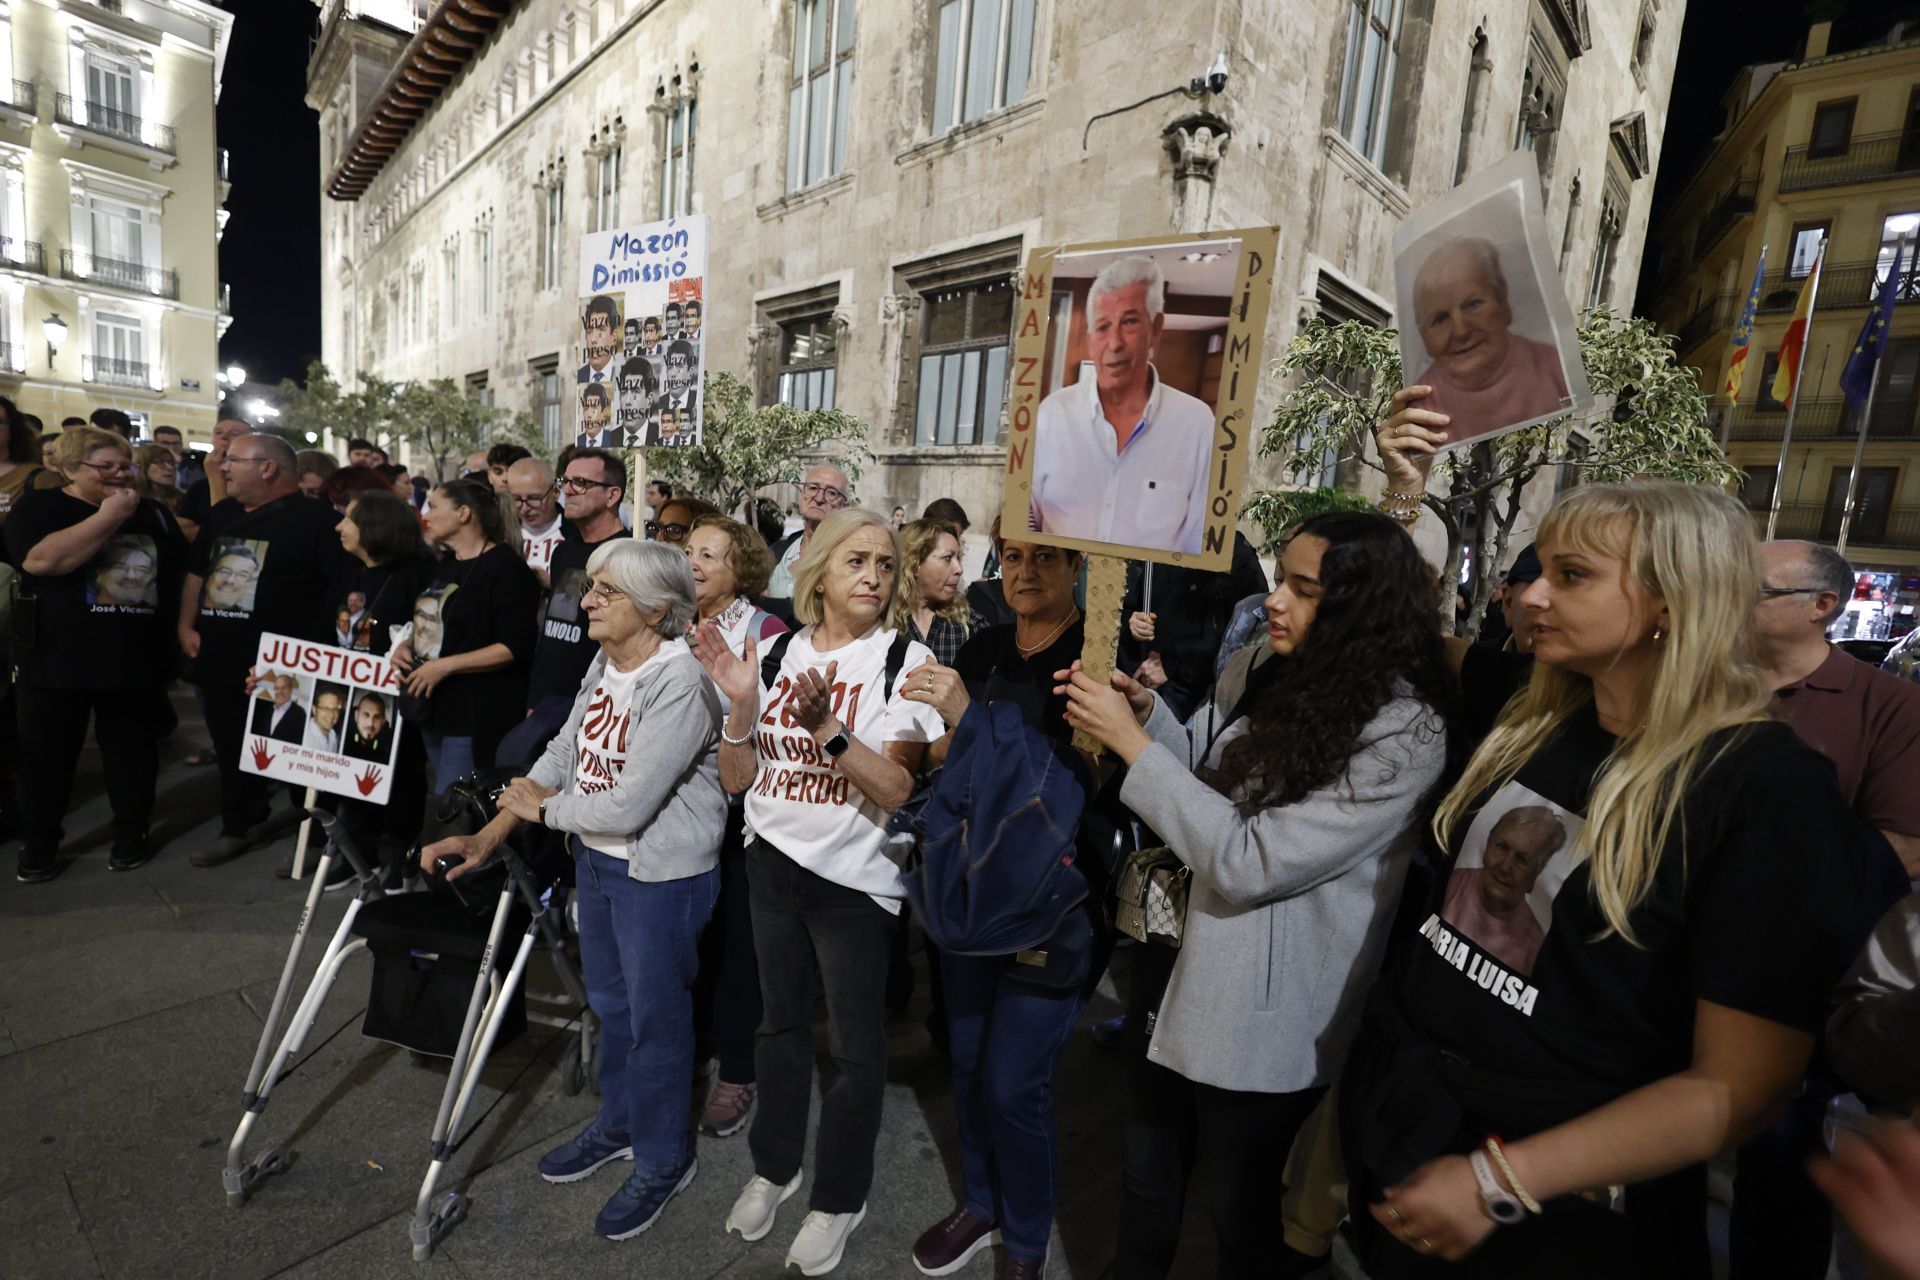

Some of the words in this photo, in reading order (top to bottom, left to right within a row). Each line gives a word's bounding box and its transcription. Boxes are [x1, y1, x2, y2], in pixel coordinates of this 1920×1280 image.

[609, 219, 688, 260] Mazón
[592, 251, 688, 291] Dimissió
[1008, 271, 1046, 474] MAZÓN
[544, 619, 582, 643] ANOLO
[262, 640, 399, 691] JUSTICIA
[282, 745, 299, 755] por
[301, 749, 315, 760] mi
[315, 751, 351, 768] marido
[757, 730, 781, 761] NI
[288, 760, 296, 769] y
[296, 762, 314, 774] mis
[315, 765, 341, 780] hijos
[1418, 913, 1470, 972] MRIA
[1466, 952, 1540, 1017] LUISA
